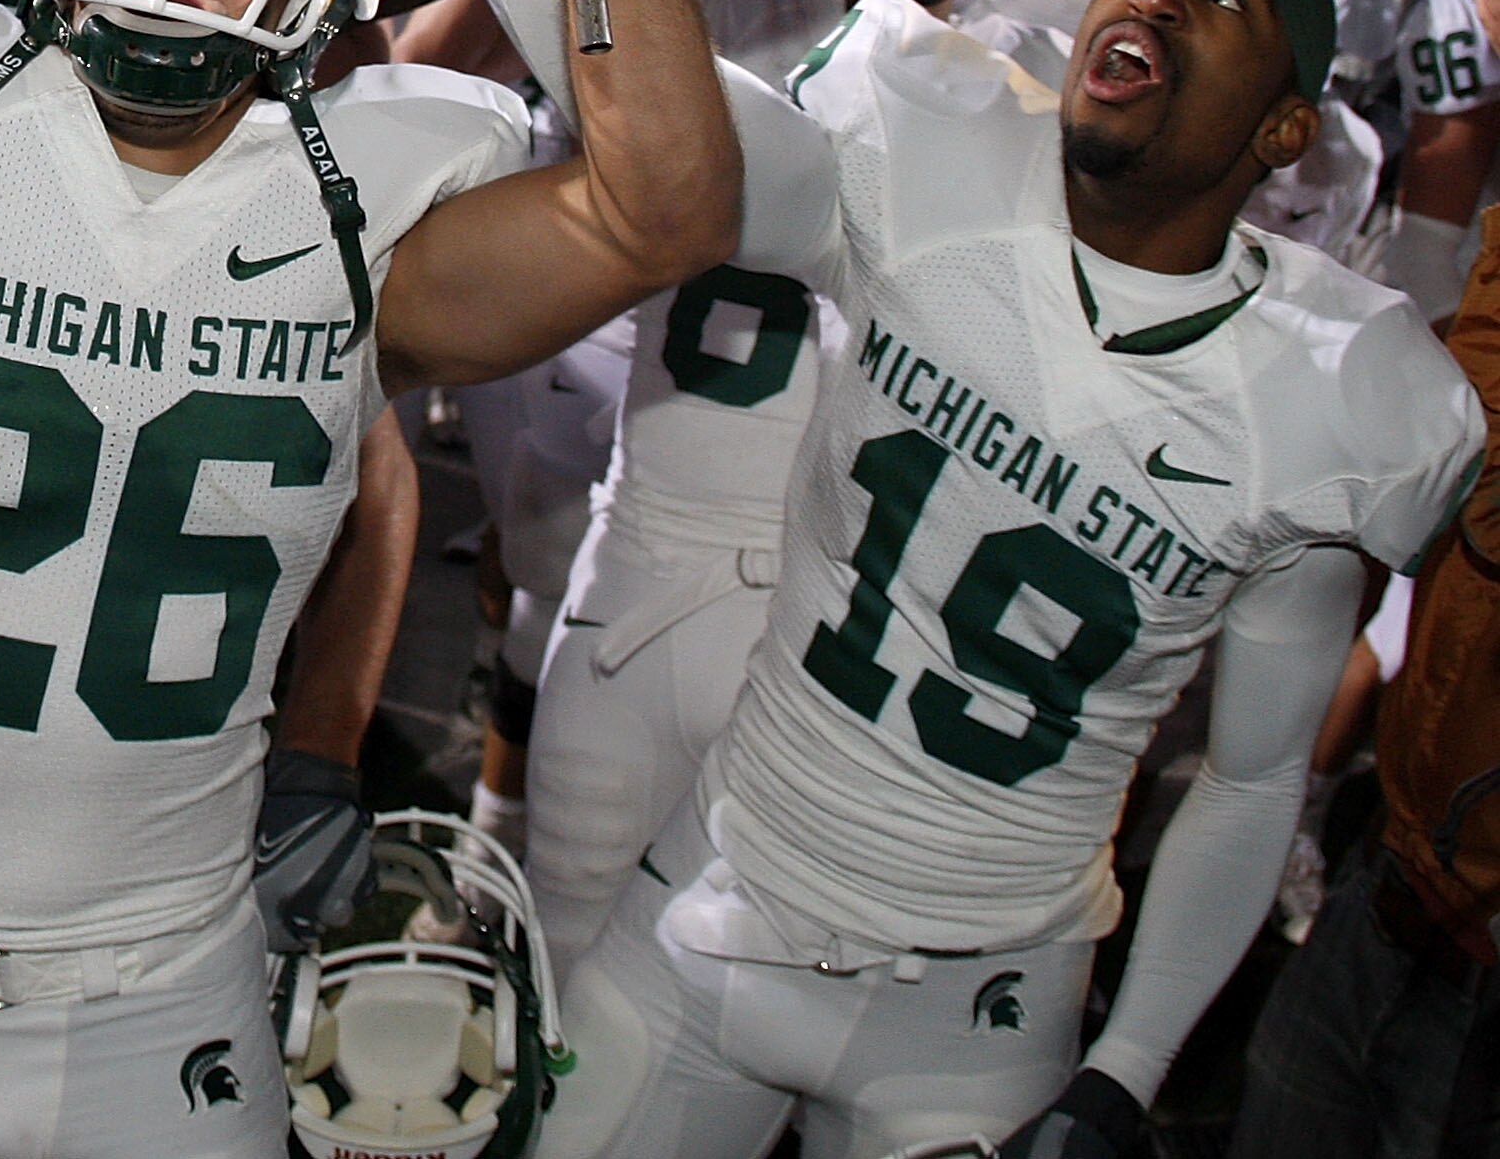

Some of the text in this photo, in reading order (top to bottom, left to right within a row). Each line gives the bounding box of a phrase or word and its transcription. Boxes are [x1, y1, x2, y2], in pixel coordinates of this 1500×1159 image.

[1411, 31, 1482, 104] 96
[188, 315, 353, 383] STATE
[858, 318, 1079, 514] MICHIGAN
[1076, 485, 1226, 597] STATE
[802, 428, 1142, 787] 19
